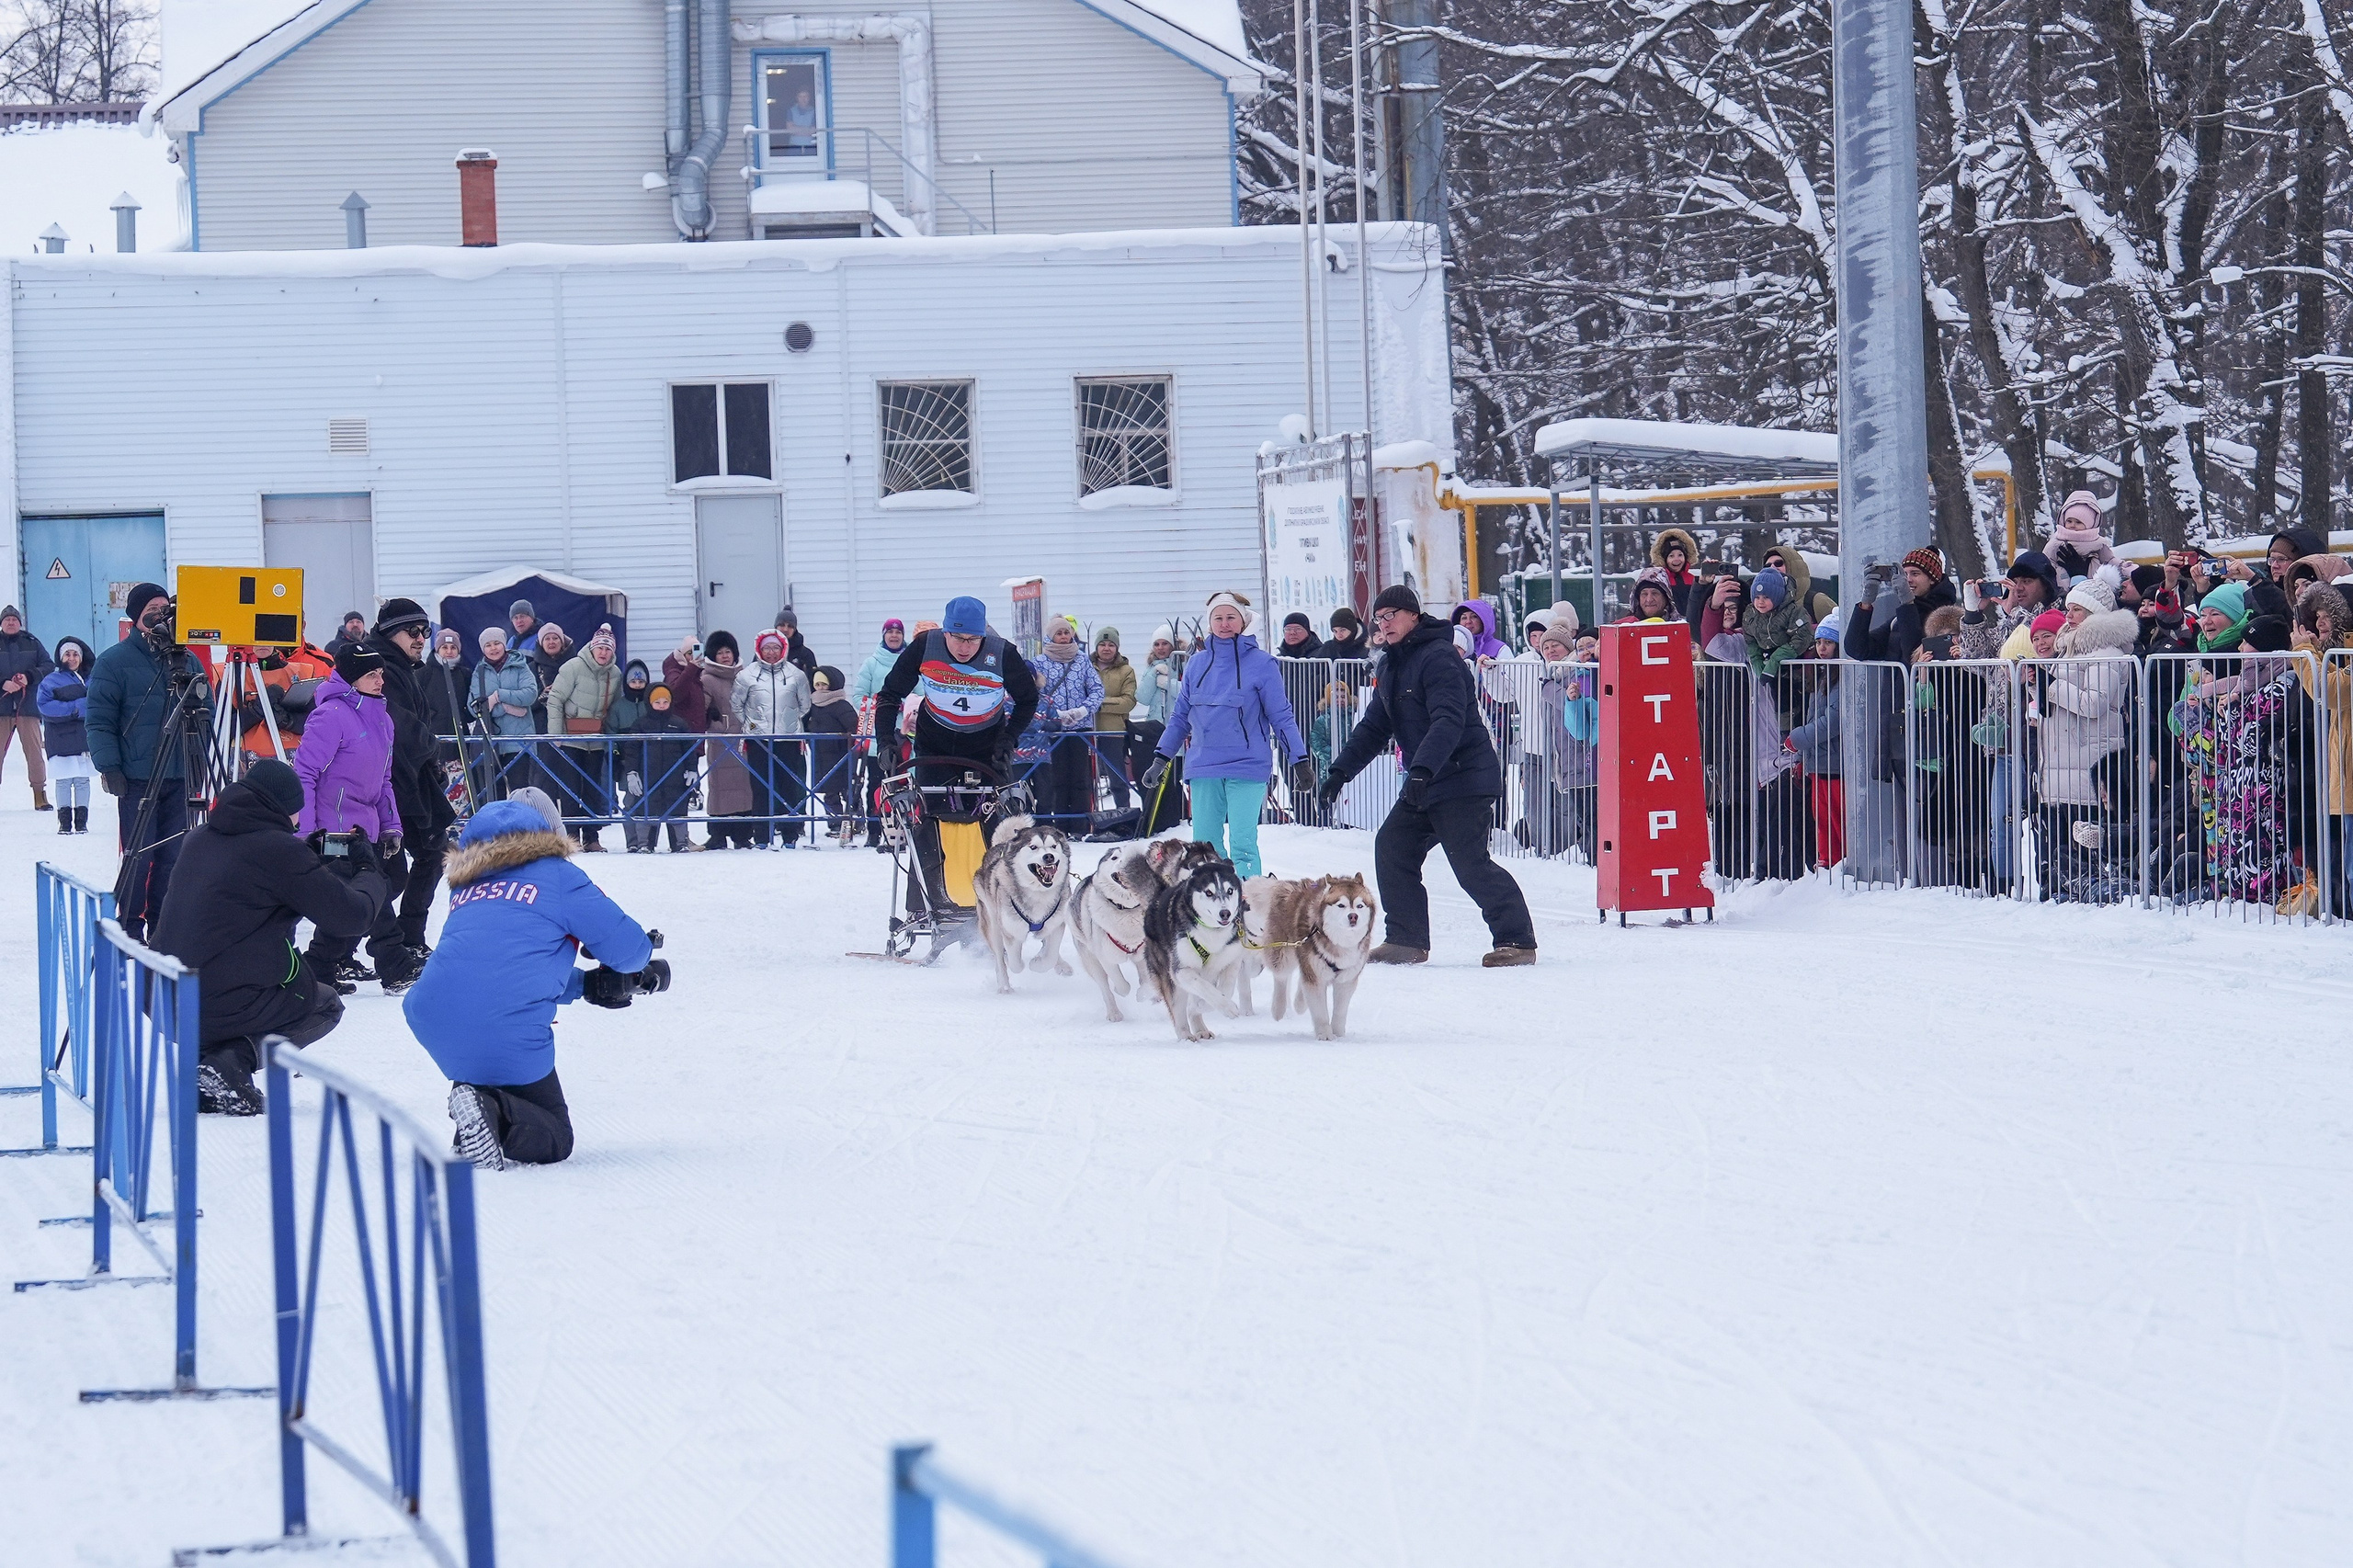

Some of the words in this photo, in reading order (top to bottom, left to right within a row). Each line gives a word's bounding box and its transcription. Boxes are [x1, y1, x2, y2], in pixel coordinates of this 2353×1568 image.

[943, 676, 979, 687] Чайка
[952, 697, 971, 711] 4
[1641, 636, 1678, 896] СТАРТ
[449, 881, 539, 911] RUSSIA
